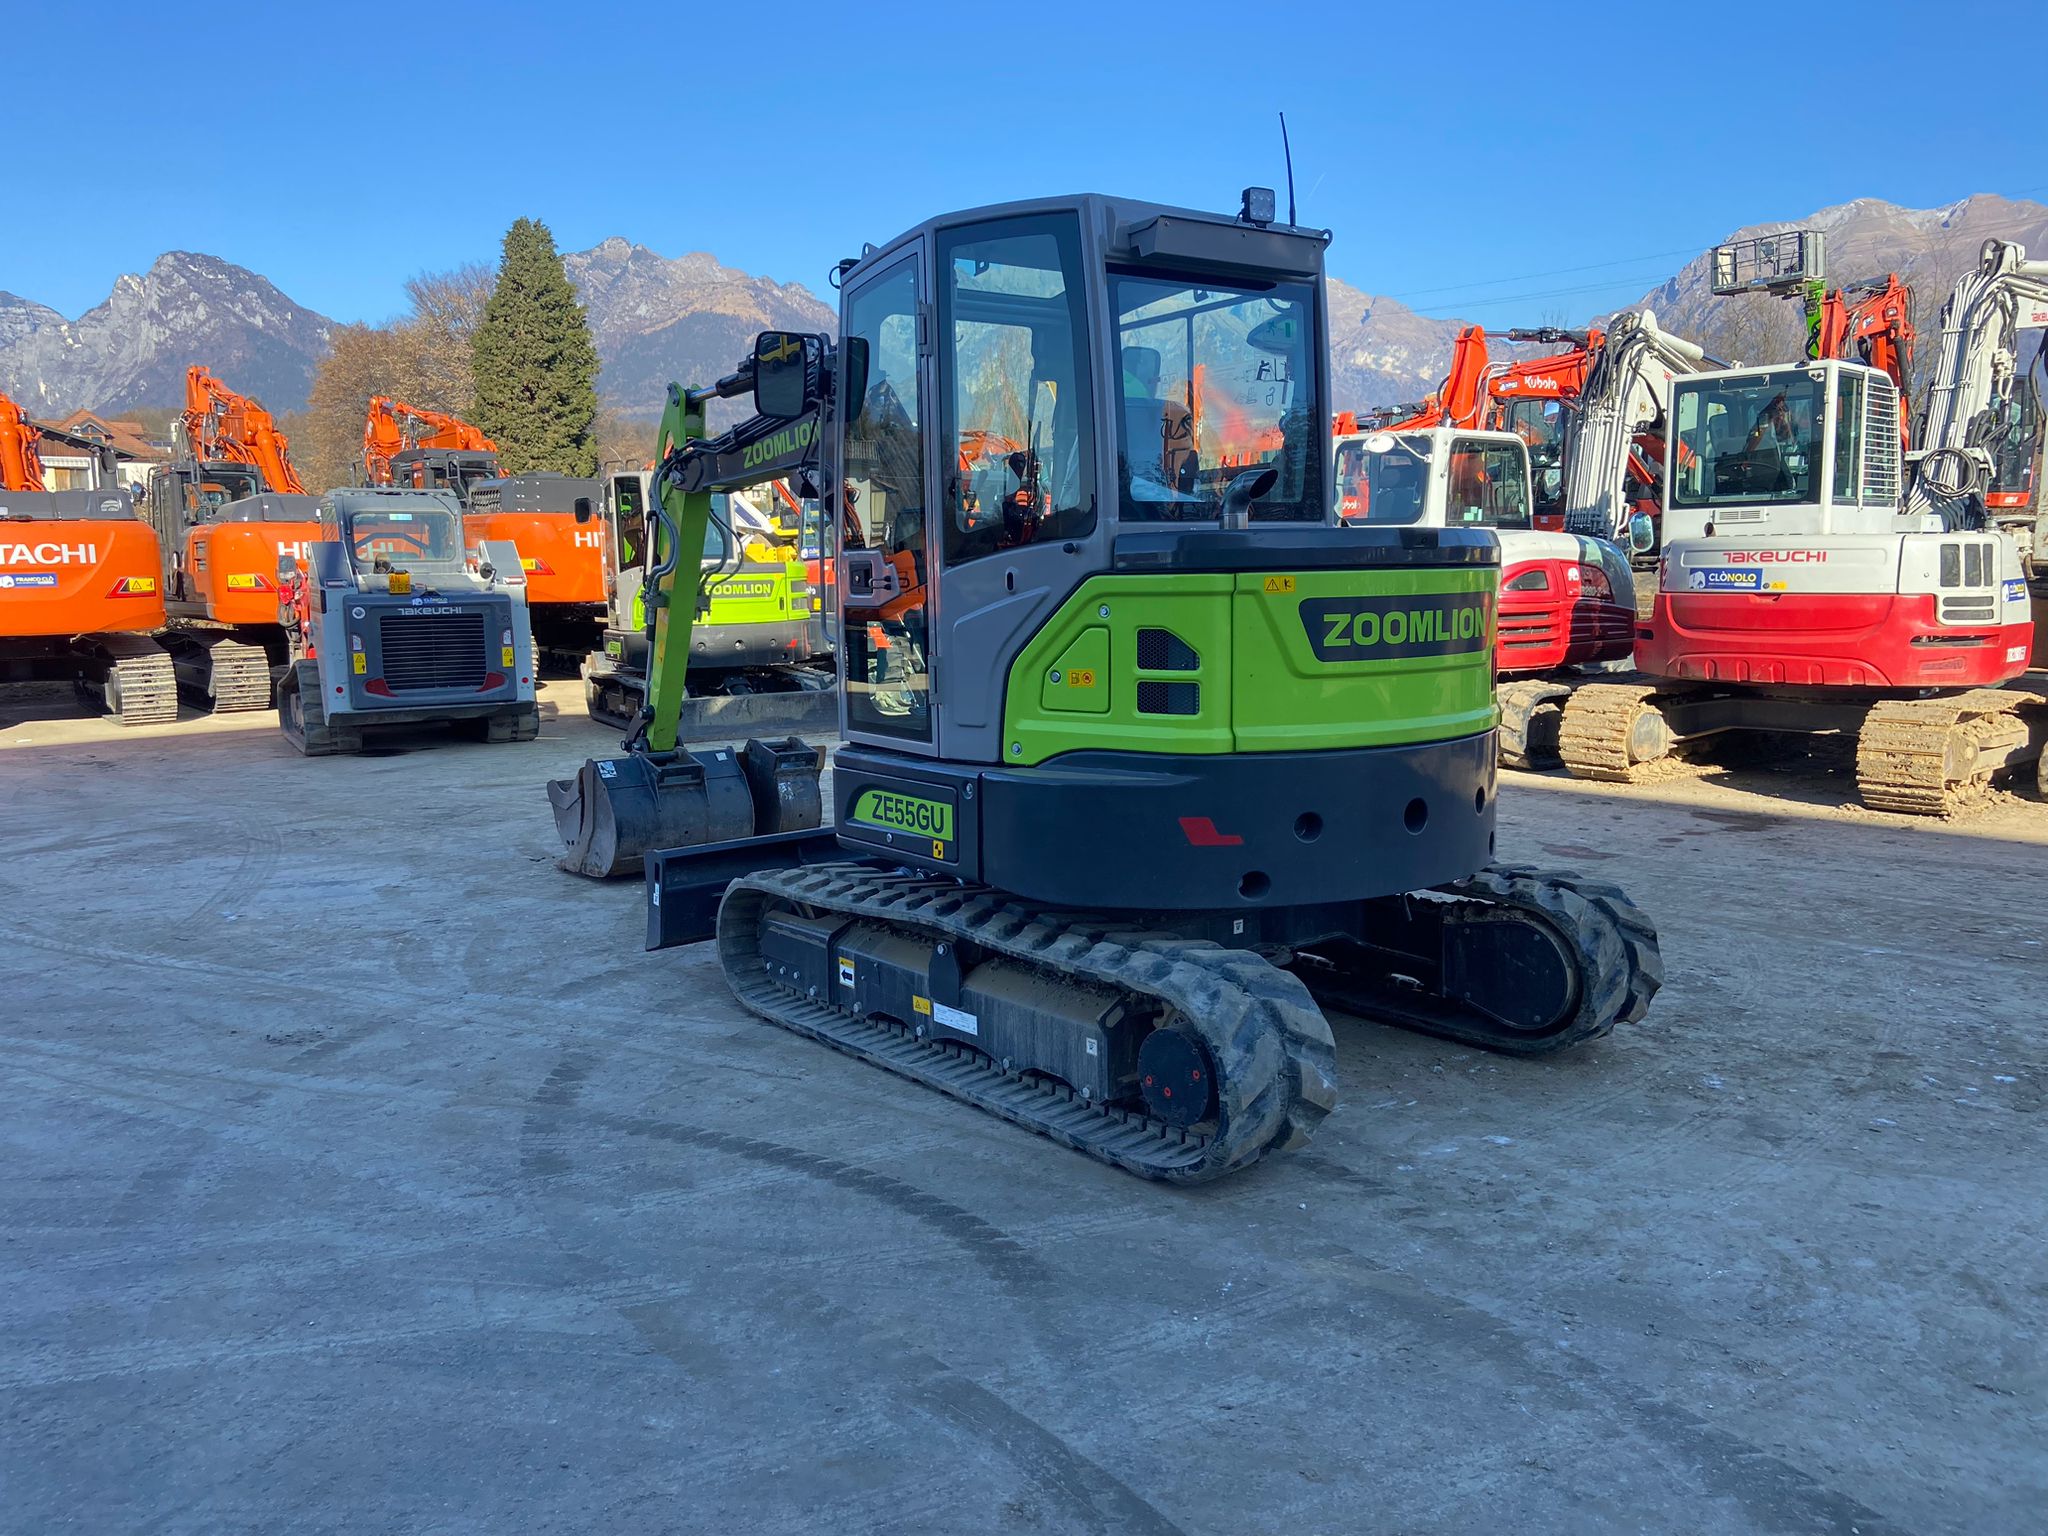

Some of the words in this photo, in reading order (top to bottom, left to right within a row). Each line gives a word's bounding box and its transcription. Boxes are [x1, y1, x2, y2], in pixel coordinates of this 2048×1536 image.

[1524, 375, 1558, 390] Kubota
[1723, 551, 1827, 563] TAKEUCHI
[1708, 570, 1757, 582] CLÒNOLO
[397, 607, 462, 615] TAKEUCHI
[1323, 608, 1487, 647] ZOOMLION
[872, 793, 945, 833] ZE55GU
